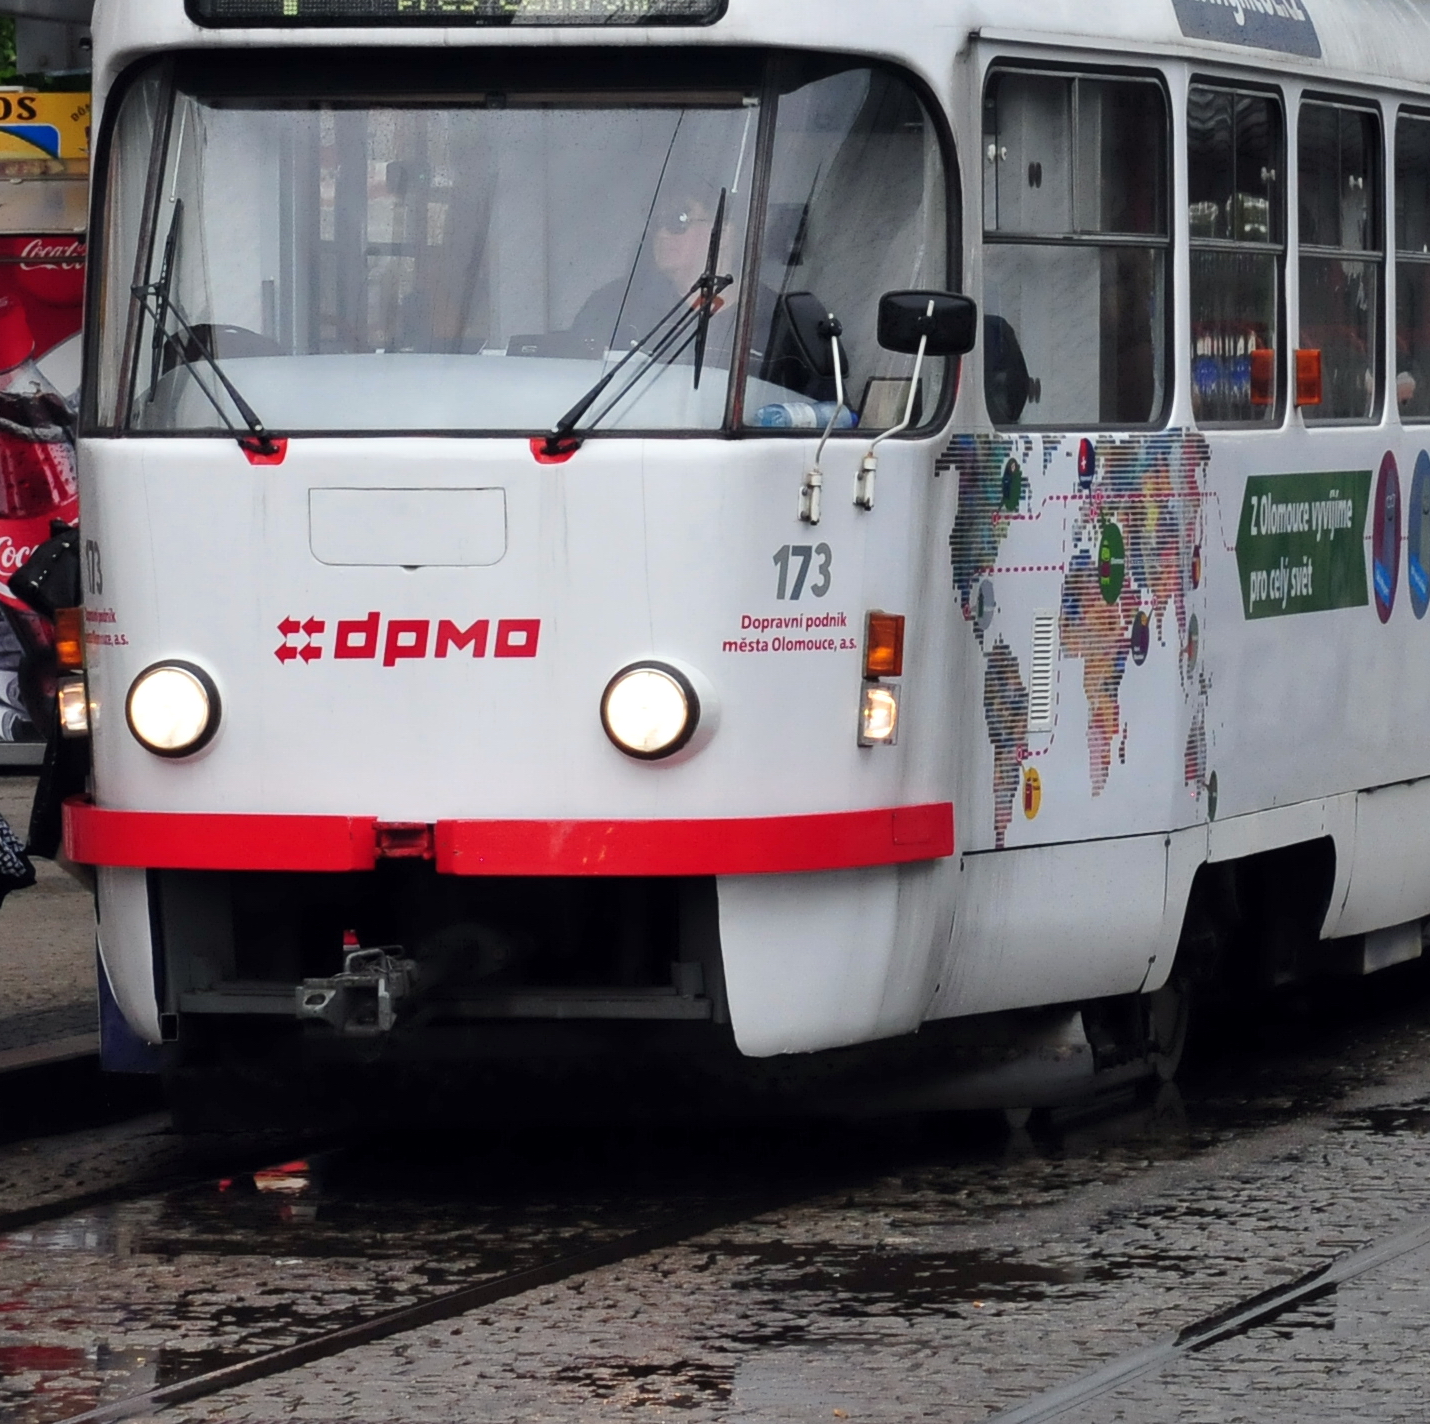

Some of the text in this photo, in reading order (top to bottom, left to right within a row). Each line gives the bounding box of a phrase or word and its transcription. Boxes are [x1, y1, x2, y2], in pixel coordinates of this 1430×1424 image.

[1250, 495, 1259, 536] Z
[1259, 492, 1310, 536] Olomouce
[772, 542, 833, 601] 173
[1249, 555, 1313, 613] pro celý svět
[722, 636, 858, 653] města Olomouce, a.s.
[740, 612, 848, 633] Dopravní podnik
